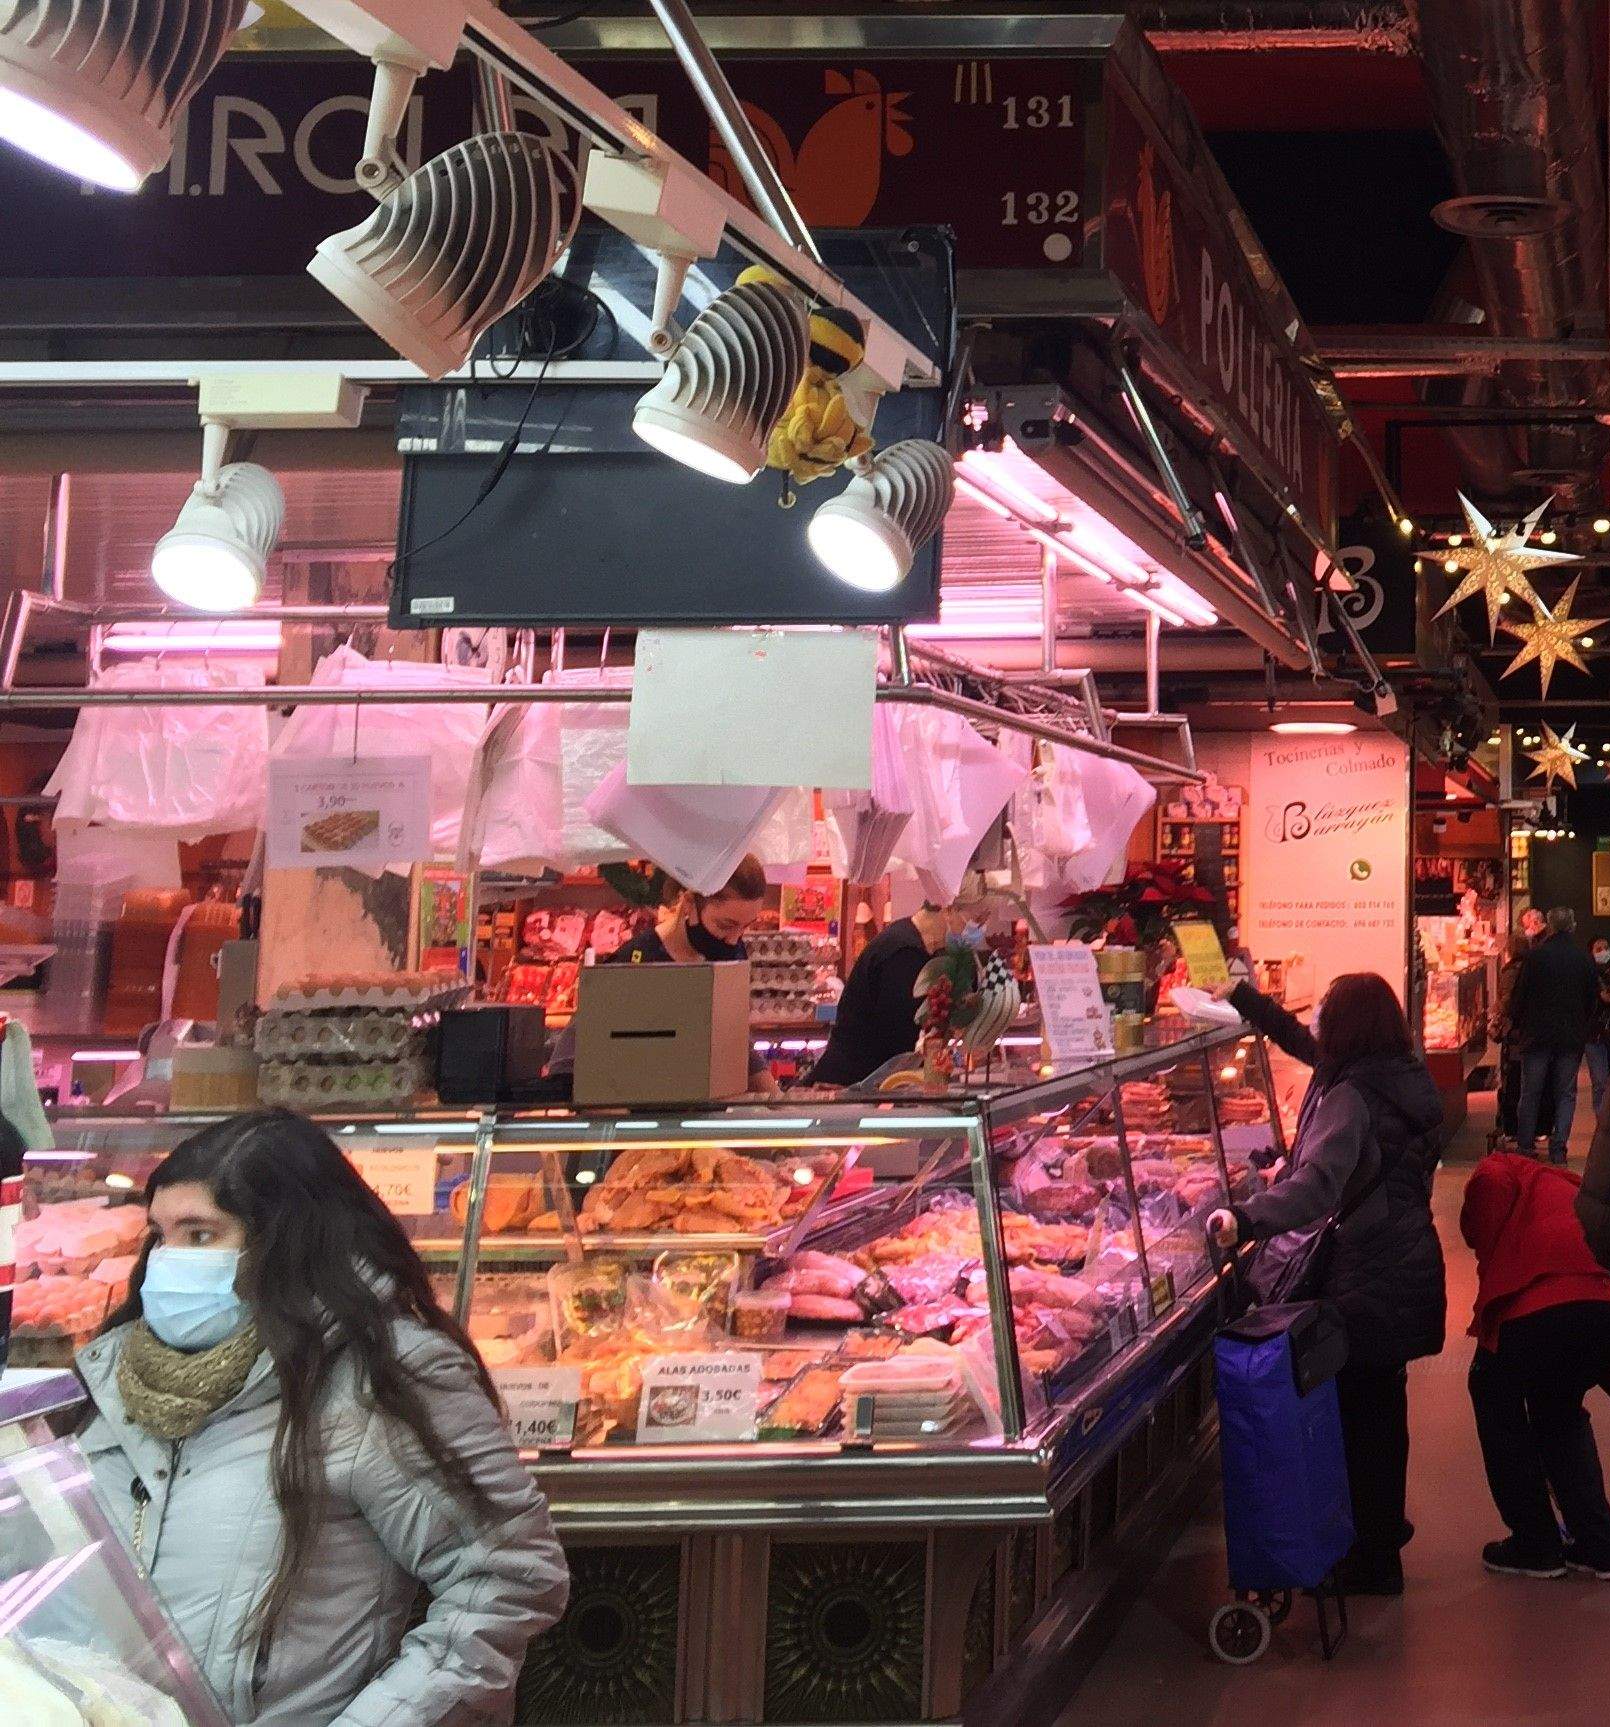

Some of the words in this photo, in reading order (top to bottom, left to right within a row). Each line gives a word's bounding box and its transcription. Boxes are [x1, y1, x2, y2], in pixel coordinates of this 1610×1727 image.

[1002, 94, 1074, 129] 131
[1001, 190, 1080, 226] 132
[1201, 246, 1303, 493] POLLERIA
[1326, 753, 1396, 777] Colmado
[658, 1365, 687, 1376] ALAS
[689, 1363, 751, 1375] ADOBADAS
